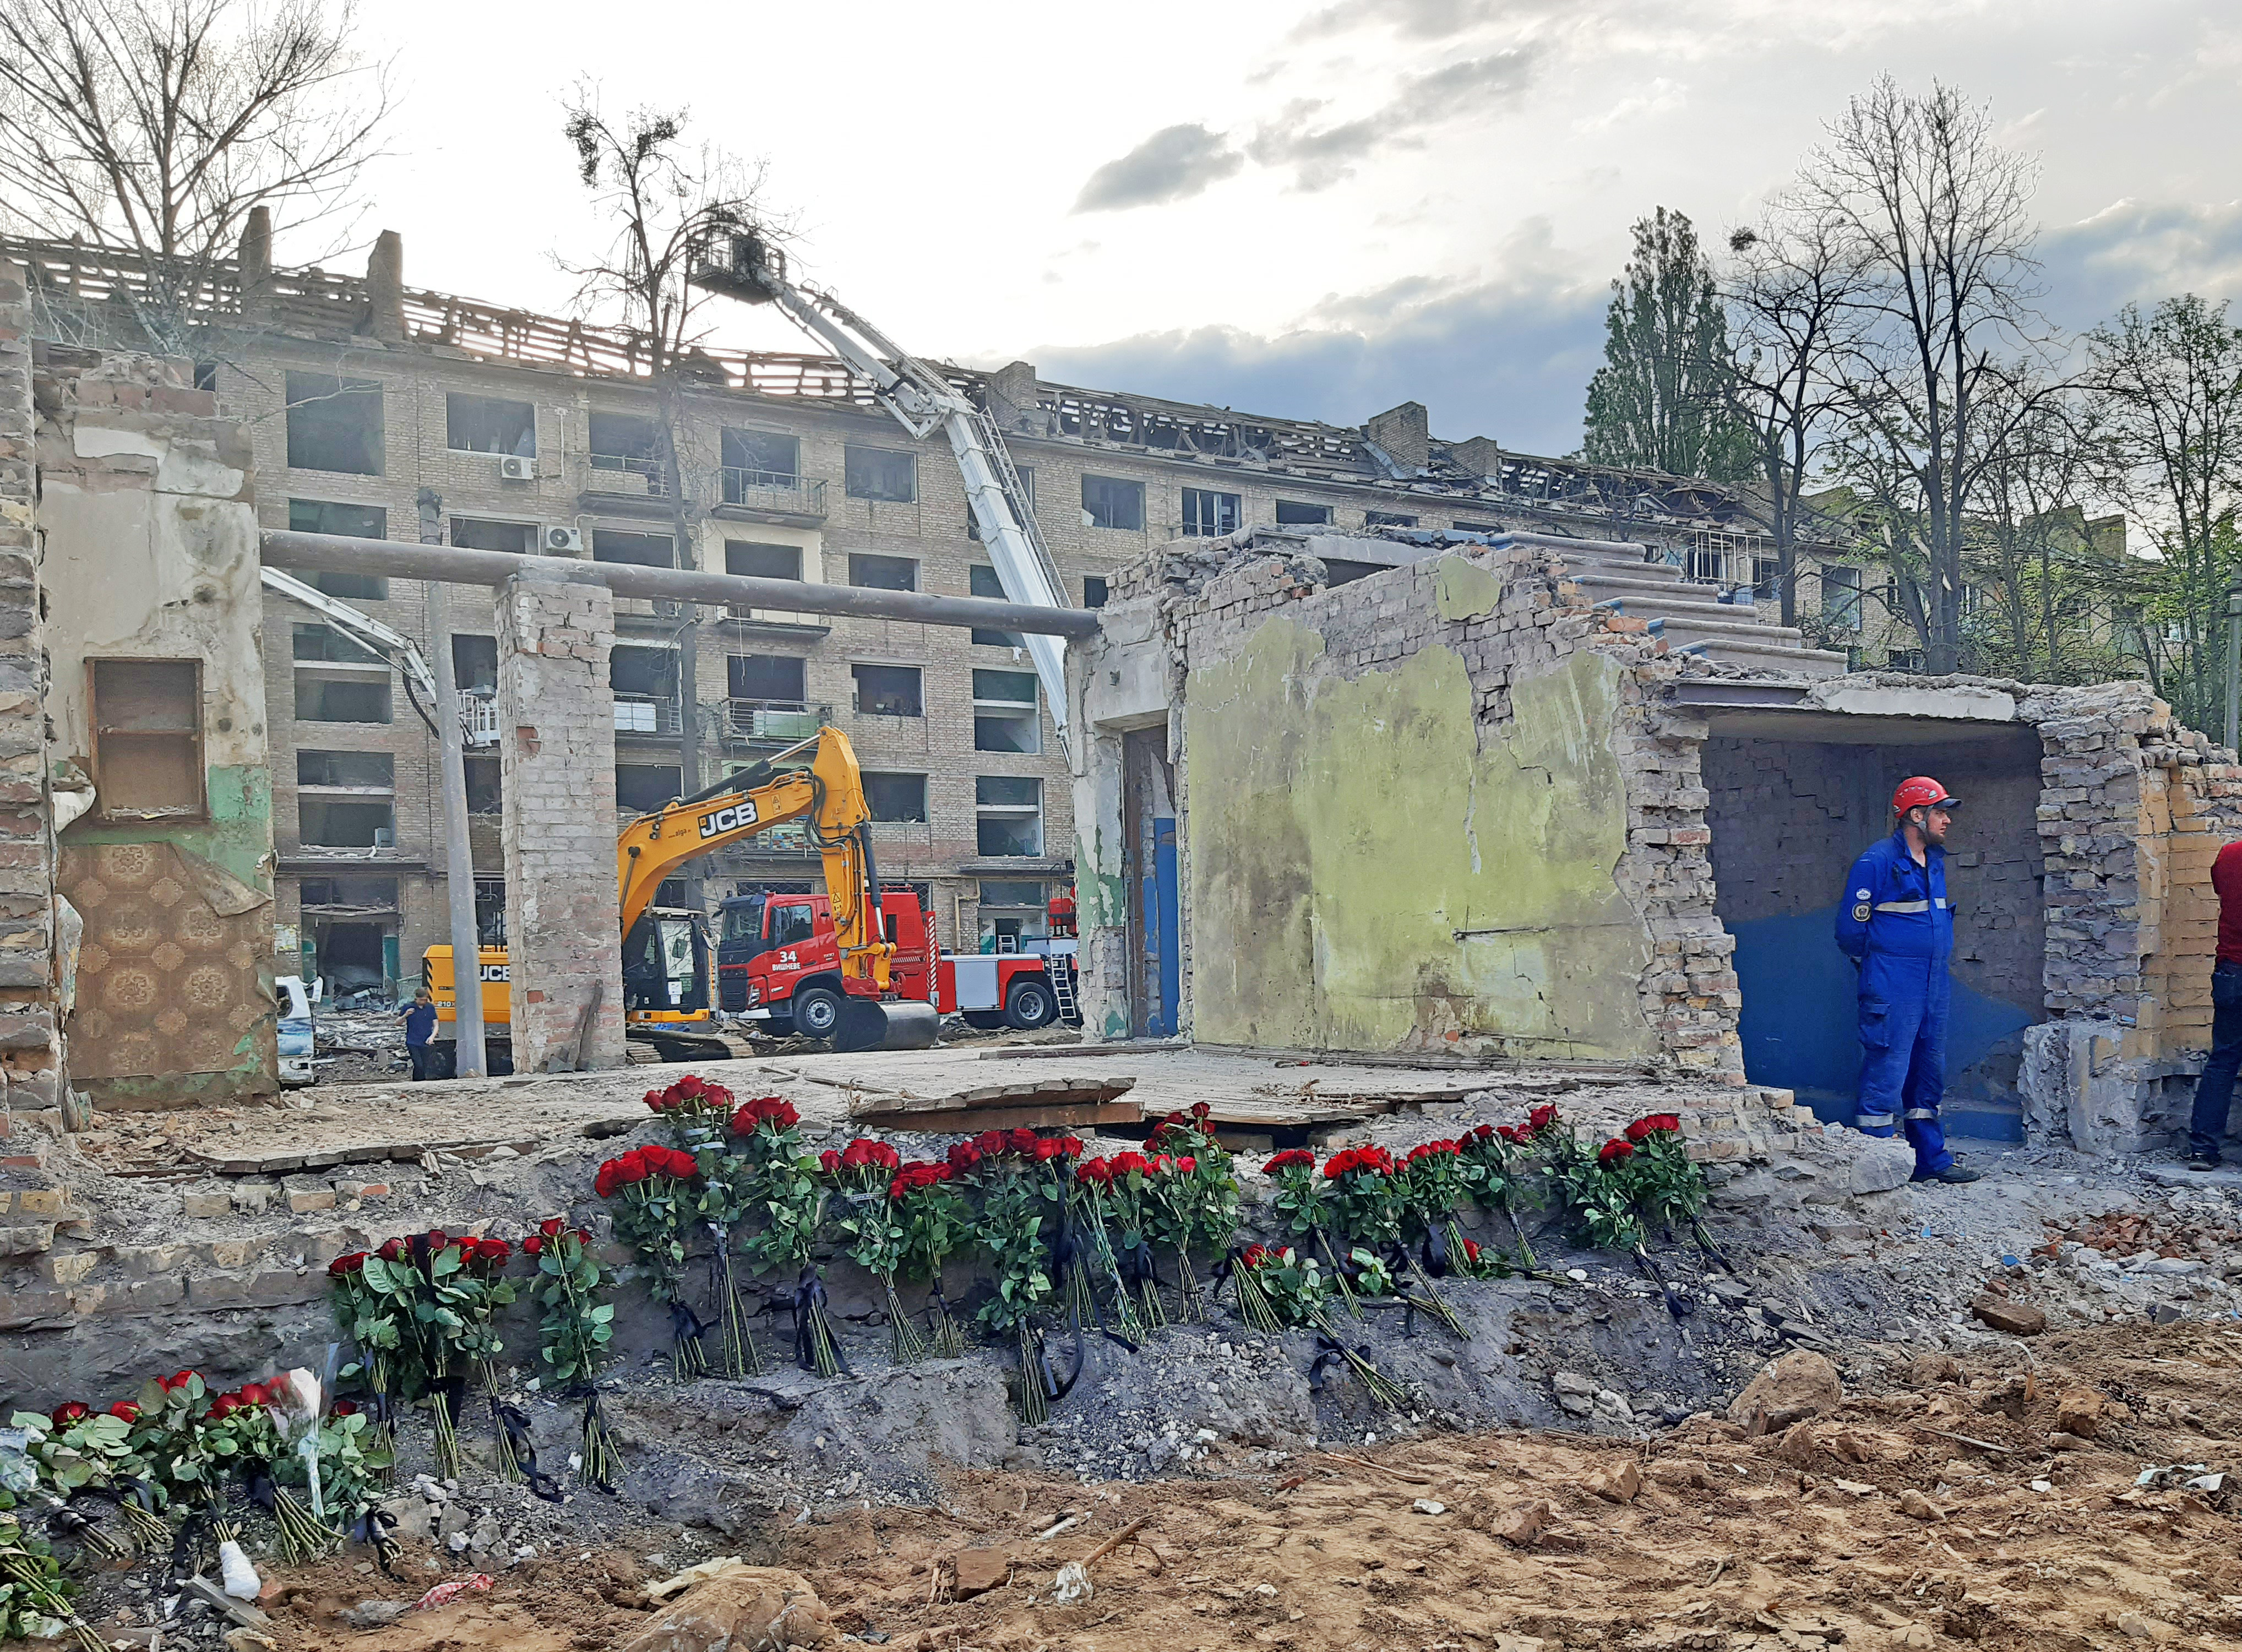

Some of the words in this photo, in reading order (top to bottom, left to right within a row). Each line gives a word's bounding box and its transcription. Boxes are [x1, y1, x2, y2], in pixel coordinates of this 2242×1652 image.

[701, 802, 757, 836] JCB
[780, 950, 797, 963] 34
[772, 963, 801, 971] ВИШНЕВЕ
